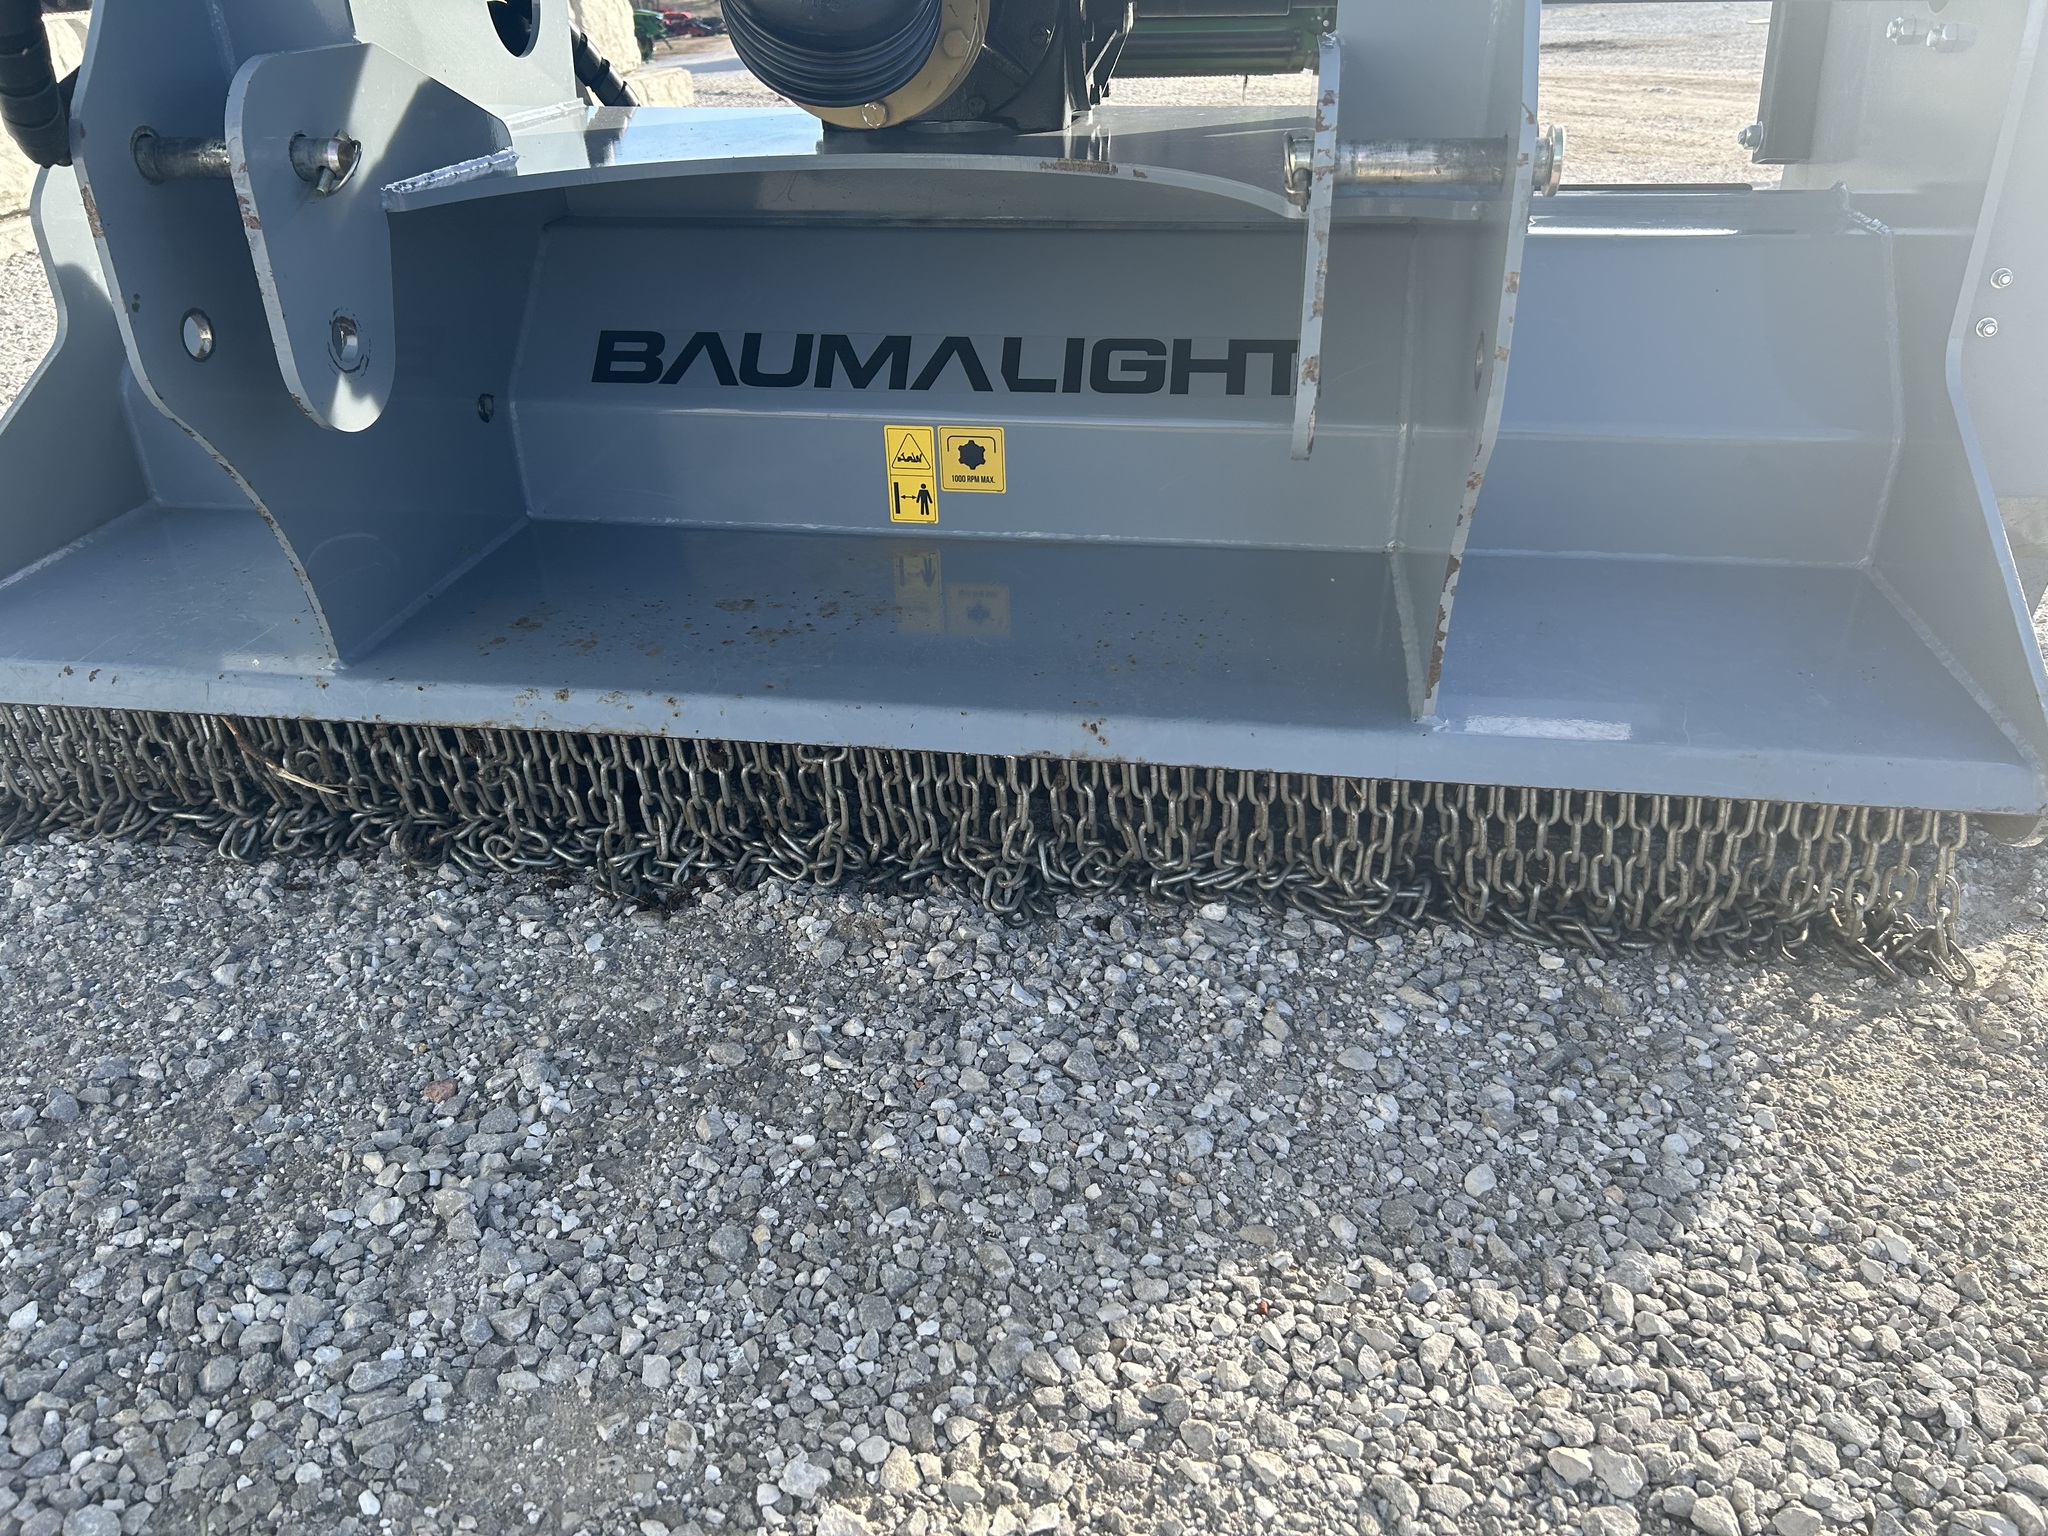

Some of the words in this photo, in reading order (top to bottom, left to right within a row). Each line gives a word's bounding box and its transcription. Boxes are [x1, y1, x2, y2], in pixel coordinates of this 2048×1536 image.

[591, 329, 1299, 395] BAUMALIGHT
[951, 474, 966, 483] 1000
[967, 475, 980, 483] RPM
[980, 475, 995, 483] MAX.
